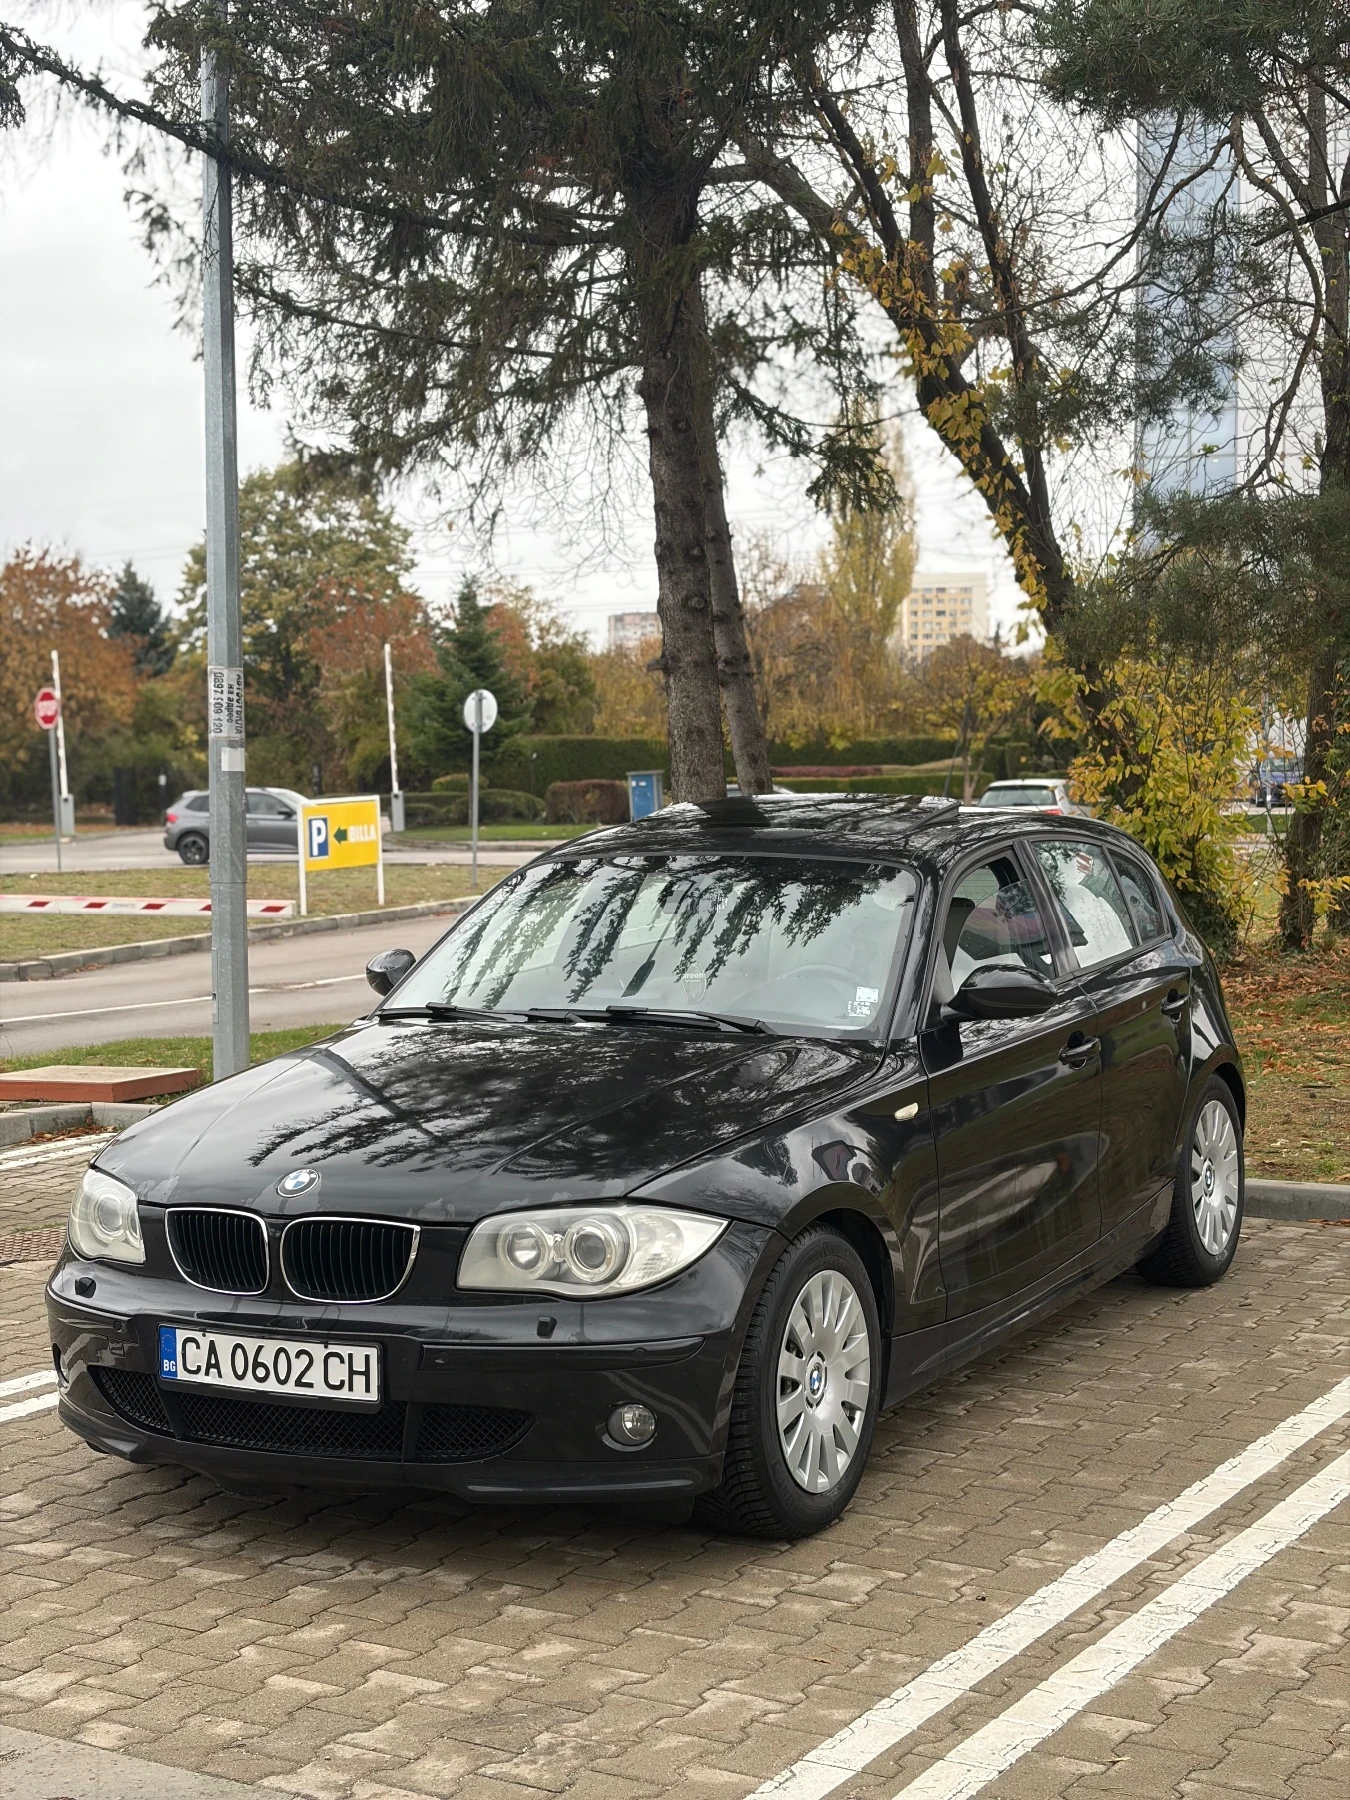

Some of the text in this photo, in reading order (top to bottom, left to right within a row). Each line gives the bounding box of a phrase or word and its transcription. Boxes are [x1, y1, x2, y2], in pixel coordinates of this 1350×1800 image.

[212, 717, 223, 735] 120
[311, 819, 326, 856] P
[347, 824, 377, 843] BILLA
[163, 1359, 176, 1372] BG
[230, 1342, 315, 1389] 0602
